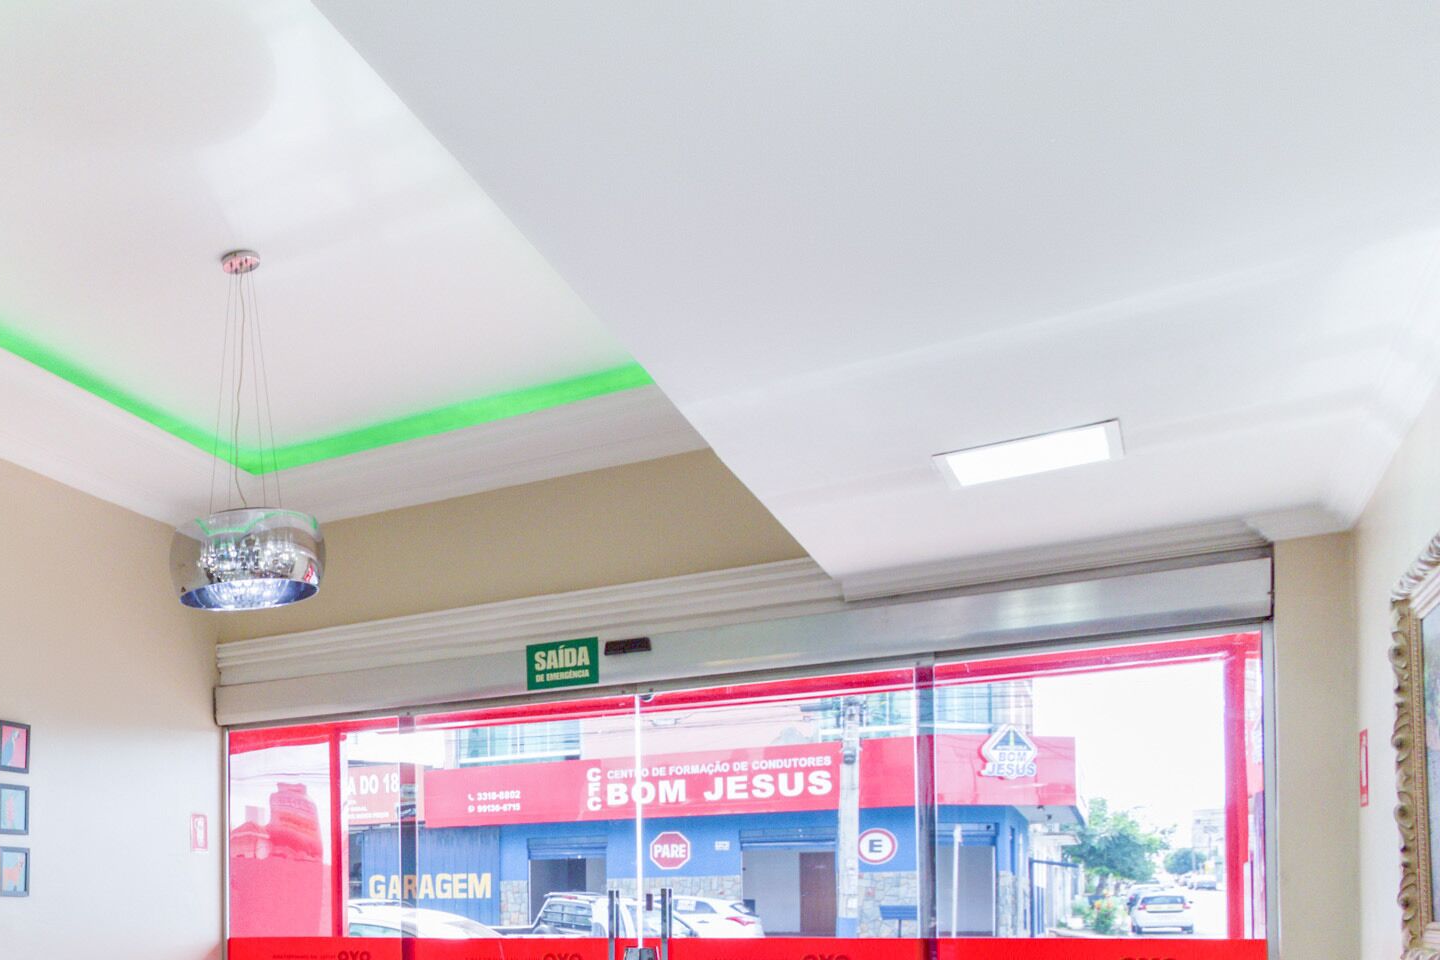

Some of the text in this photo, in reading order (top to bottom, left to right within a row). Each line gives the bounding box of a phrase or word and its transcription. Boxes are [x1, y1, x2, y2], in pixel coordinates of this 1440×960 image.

[534, 645, 590, 671] SAÍDA
[535, 674, 545, 683] DE
[999, 751, 1027, 762] BOM
[607, 755, 832, 780] CENTO DE FORMAÇÃO DE CONDUTORES
[987, 763, 1035, 776] JESUS
[359, 774, 379, 795] DO
[606, 770, 833, 806] BOM JESUS
[653, 843, 687, 859] PARE
[869, 839, 882, 853] E
[368, 873, 492, 899] GARAGEM
